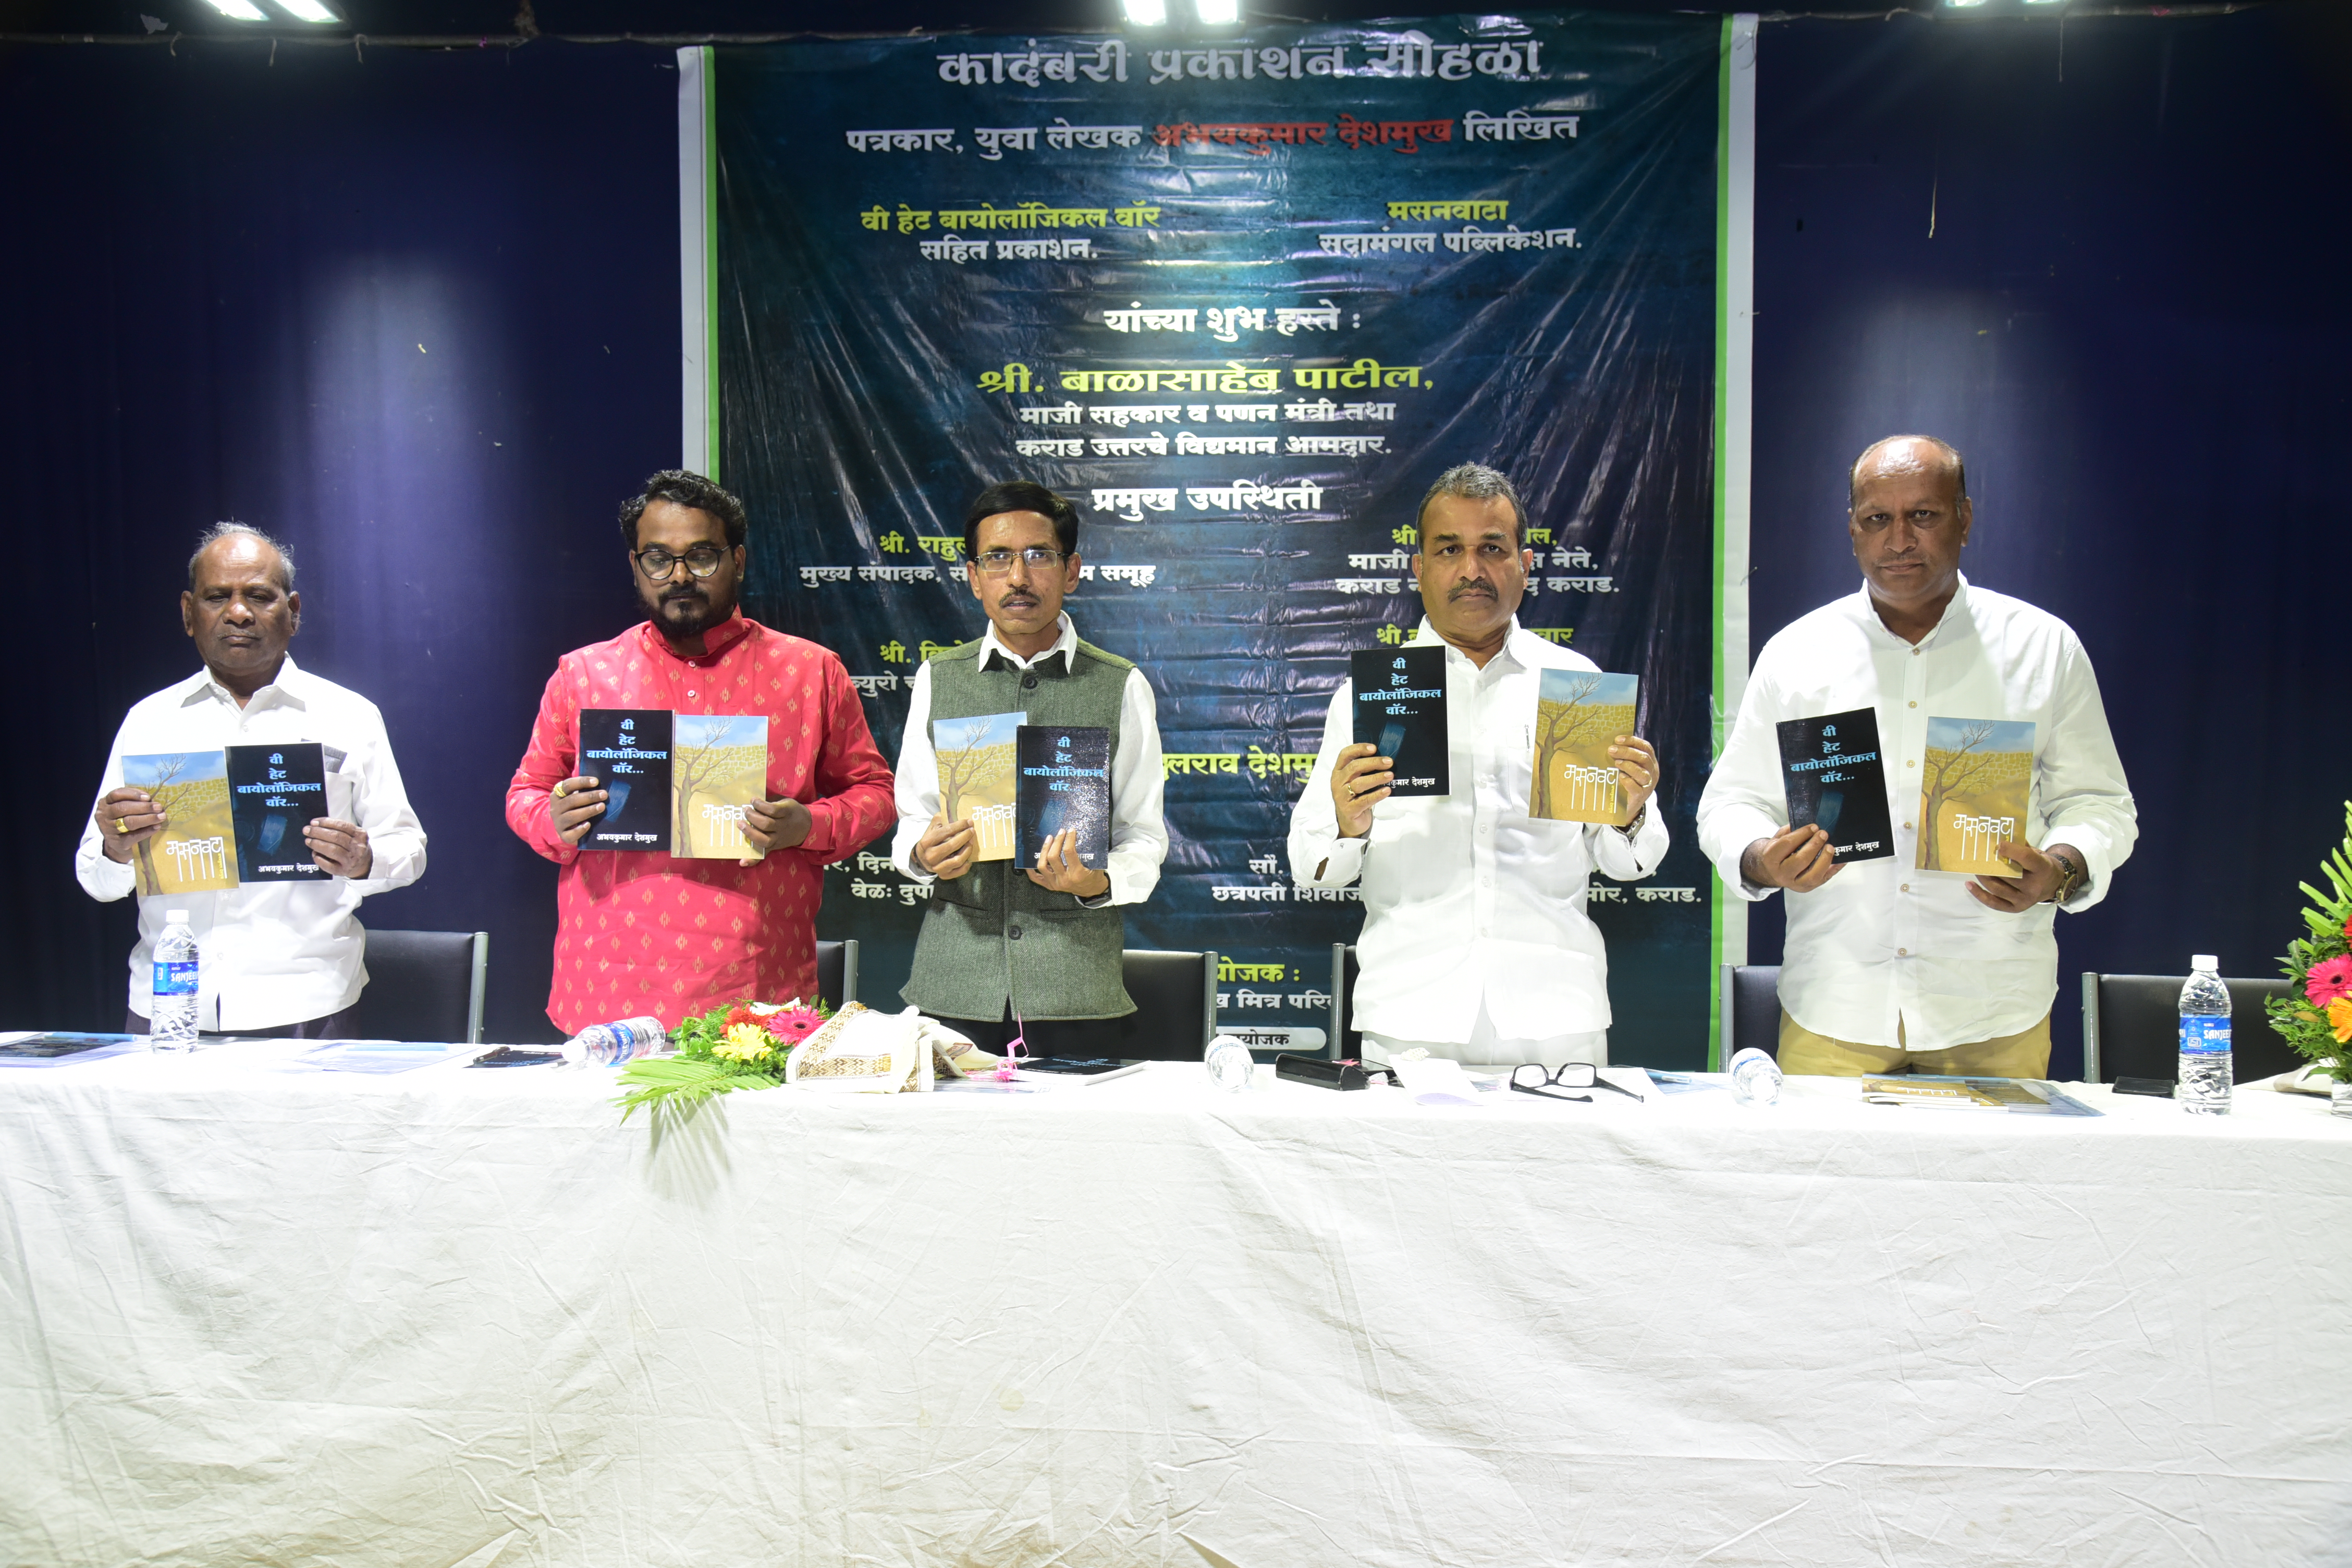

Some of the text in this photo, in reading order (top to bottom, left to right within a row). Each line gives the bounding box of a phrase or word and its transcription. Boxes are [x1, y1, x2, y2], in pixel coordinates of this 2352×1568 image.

[936, 30, 1544, 88] कादंबरी प्रकाशन सोहळा
[846, 110, 1579, 161] पत्रकार, युवा लेखक अभयकुमार देशमुख लिखित
[861, 200, 1161, 235] वी हेट बायोलॉजिकल वॉर
[1387, 200, 1509, 222] मसनवाटा
[920, 234, 1098, 264] सहित प्रकाशन.
[1319, 225, 1582, 258] सदामंगल पब्लिकेशन.
[1104, 301, 1197, 333] यांच्या
[1207, 306, 1267, 342] शुभ
[1275, 299, 1341, 336] हस्ते
[976, 358, 1433, 393] श्री. बाळासाहेब पाटील,
[1019, 397, 1396, 427] माजी सहकार व पणन मंत्री तथा
[1015, 431, 1392, 458] कराड उत्तरचे विद्यमान आमदार.
[1092, 479, 1324, 522] प्रमुख उपस्थिती
[879, 530, 910, 554] श्री.
[1348, 548, 1410, 570] माजी
[1551, 546, 1598, 570] नेते,
[800, 566, 852, 589] मुख्य
[858, 561, 941, 584] संपादक,
[1100, 565, 1156, 587] समूह
[1335, 578, 1402, 595] कराड
[1546, 577, 1620, 593] कराड.
[879, 640, 911, 663] श्री.
[1392, 657, 1406, 669] वी
[1391, 673, 1408, 685] हेट
[1359, 688, 1441, 701] बायोलॉजिकल
[621, 719, 634, 730] वी
[1822, 725, 1836, 737] वी
[618, 733, 635, 745] हेट
[1057, 737, 1071, 748] वी
[1822, 741, 1841, 754] हेट
[269, 753, 283, 765] वी
[586, 747, 667, 760] बायोलॉजिकल
[1055, 751, 1072, 763] हेट
[1790, 752, 1877, 772] बायोलॉजिकल
[268, 768, 287, 780] हेट
[1024, 765, 1104, 777] बायोलॉजिकल
[237, 782, 322, 793] बायोलॉजिकल
[1412, 776, 1436, 788] देशमुख
[597, 832, 657, 843] अभयकुमार देशमुख
[1855, 841, 1879, 851] देशमुख
[258, 864, 294, 874] अभयकुमार
[1249, 854, 1283, 874] सौ.
[1211, 882, 1287, 902] छत्रपती
[1635, 888, 1701, 902] कराड.
[1236, 988, 1282, 1009] मित्र
